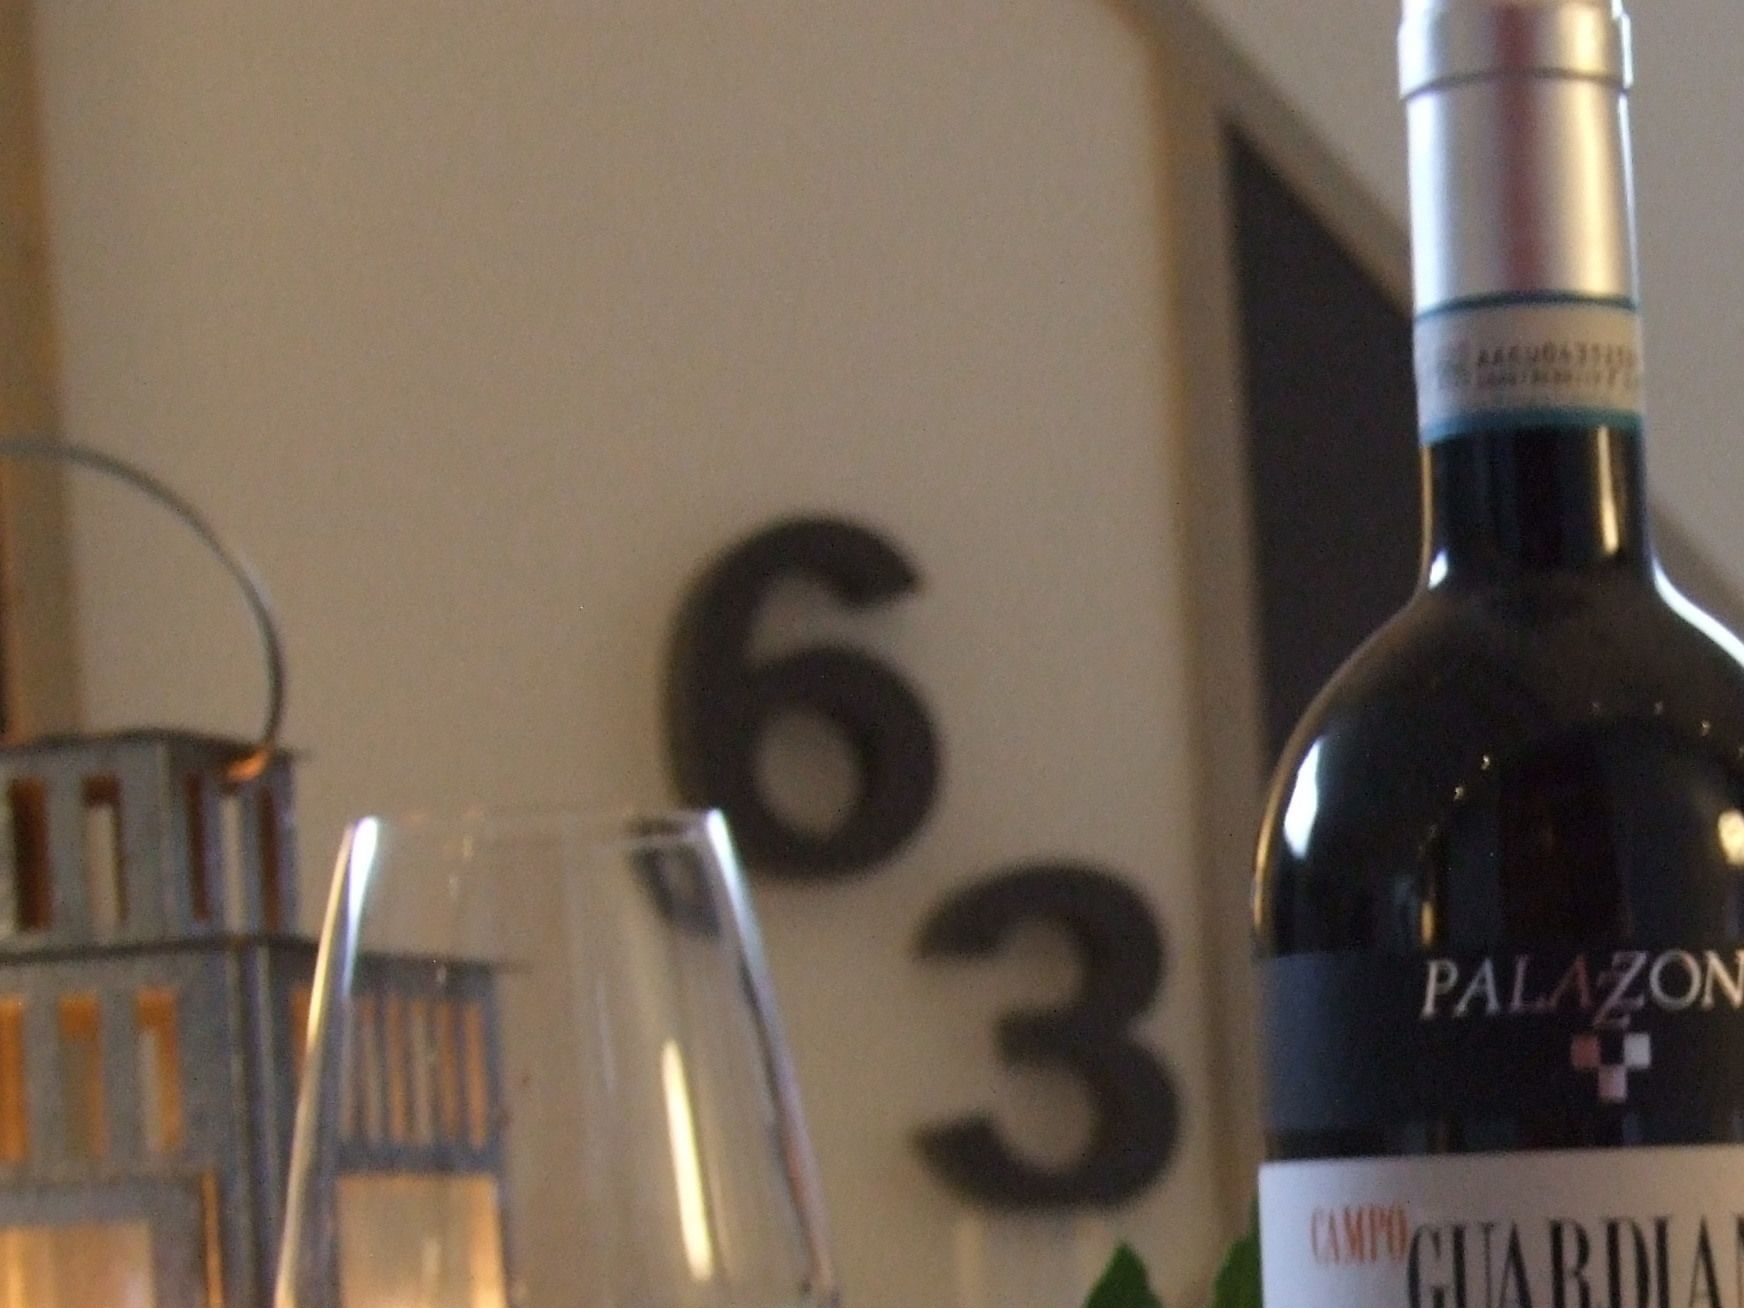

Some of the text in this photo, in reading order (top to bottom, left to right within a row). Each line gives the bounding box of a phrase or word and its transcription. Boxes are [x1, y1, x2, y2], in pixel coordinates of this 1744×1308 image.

[663, 512, 943, 883] 6
[911, 857, 1183, 1214] 3
[1310, 1203, 1407, 1266] CAMPO
